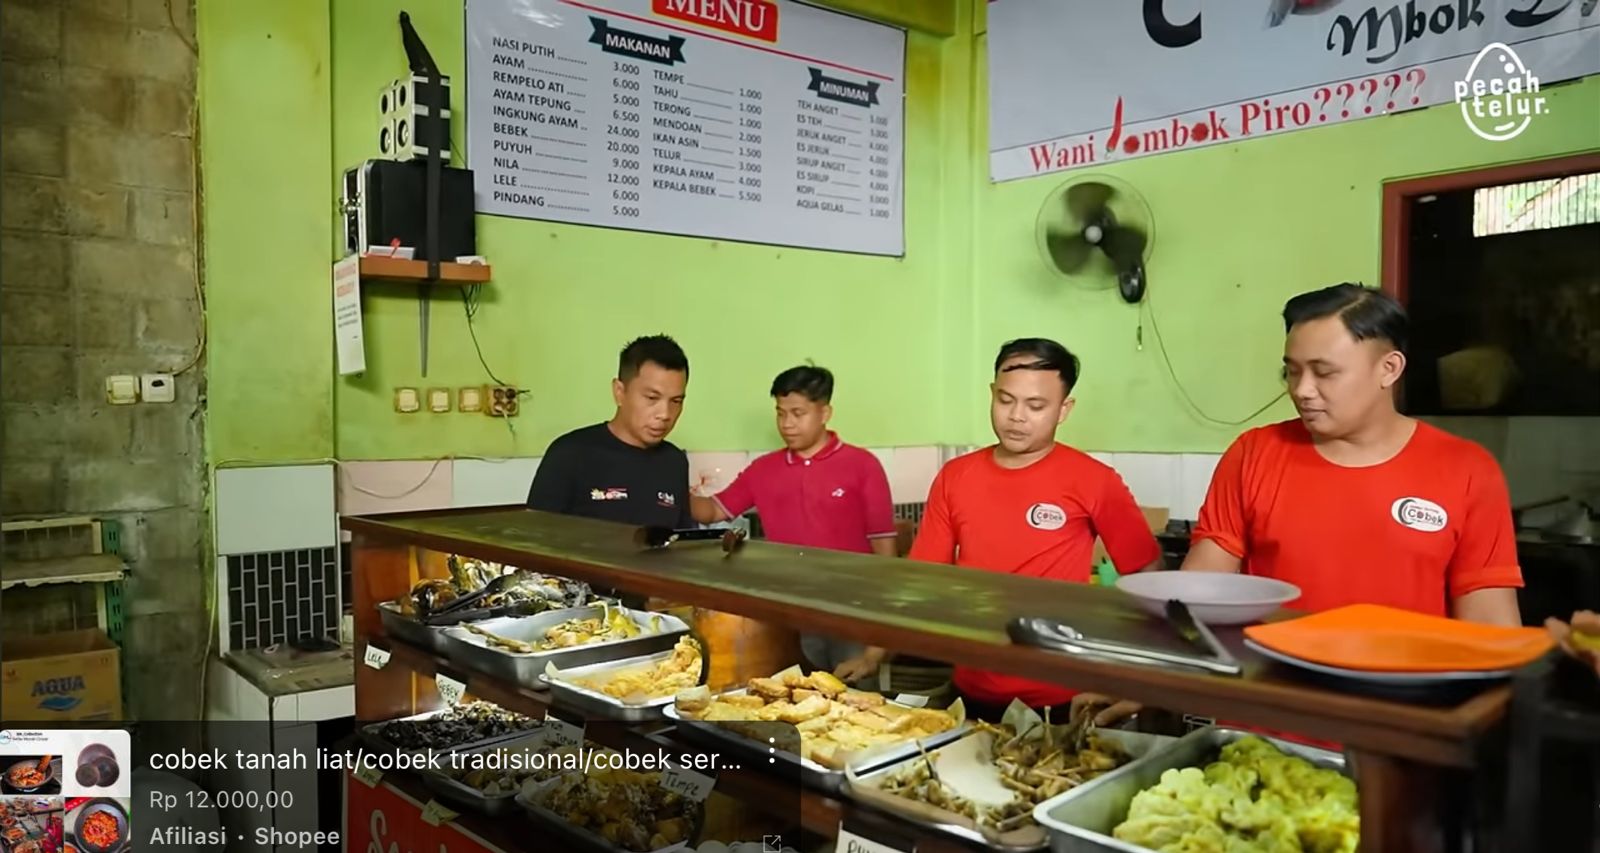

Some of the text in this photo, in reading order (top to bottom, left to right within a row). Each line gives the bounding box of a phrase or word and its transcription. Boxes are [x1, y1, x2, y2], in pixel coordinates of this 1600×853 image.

[666, 0, 767, 32] MENU
[492, 36, 640, 76] NASI PUTIH 3.000
[605, 33, 671, 59] MAKANAN
[492, 54, 640, 92] AYAM 6.000
[653, 69, 762, 101] TEMPE 1.000
[493, 71, 640, 108] REMPELO ATI 5.000
[653, 85, 762, 116] TAHU 1.000
[819, 81, 870, 102] MINUMAN
[493, 88, 640, 124] AYAM TEPUNG 6.500
[653, 101, 762, 131] TERONG 1.000
[796, 114, 806, 124] ES
[807, 115, 823, 126] TEH
[797, 99, 813, 110] TEH
[813, 103, 840, 116] ANGET
[493, 105, 640, 139] INGKUNG AYAM 24.000
[653, 117, 762, 145] MENDOAN 2.000
[493, 122, 640, 156] BEBEK 20.000
[653, 133, 676, 146] IKAN
[677, 136, 700, 149] ASIN
[796, 128, 820, 140] JERUK
[821, 133, 847, 145] ANGET
[796, 142, 806, 152] ES
[806, 144, 830, 155] JERUK
[493, 140, 640, 171] PUYUH 9.000
[653, 148, 682, 162] TELUR
[796, 156, 820, 167] SIRUP
[820, 160, 846, 172] ANGET
[1029, 134, 1096, 173] Wani
[493, 157, 640, 187] NILA 12.000
[653, 163, 687, 179] KEPALA
[689, 169, 715, 182] AYAM
[796, 170, 806, 180] ES
[807, 172, 830, 183] SIRUP
[493, 174, 640, 203] LELE 6.000
[653, 179, 687, 194] KEPALA
[688, 183, 717, 197] BEBEK
[796, 185, 816, 195] KOPI
[493, 190, 640, 218] PINDANG 5.000
[796, 199, 820, 210] AQUA
[821, 202, 844, 213] GELAS
[31, 675, 86, 697] AQUA
